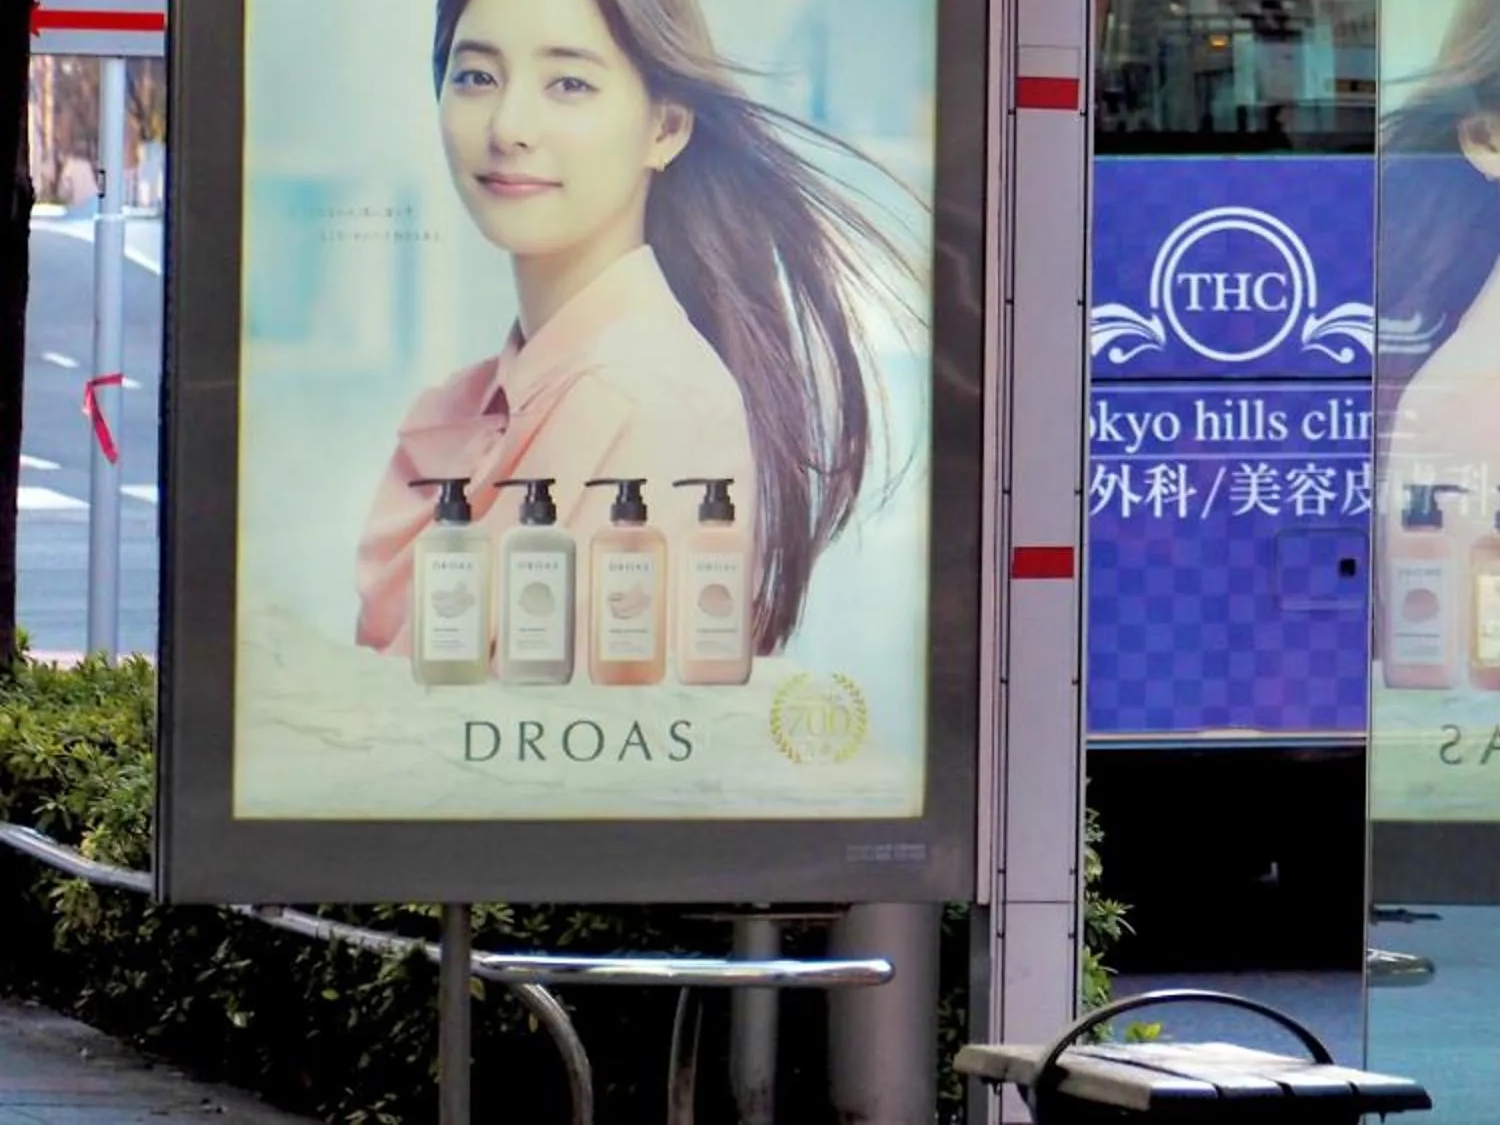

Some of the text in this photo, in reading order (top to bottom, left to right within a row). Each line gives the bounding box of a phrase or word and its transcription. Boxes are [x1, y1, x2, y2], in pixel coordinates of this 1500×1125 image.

[1178, 272, 1288, 312] THC
[1090, 401, 1180, 453] kyo
[1194, 398, 1288, 442] hills
[464, 720, 695, 763] DROAS
